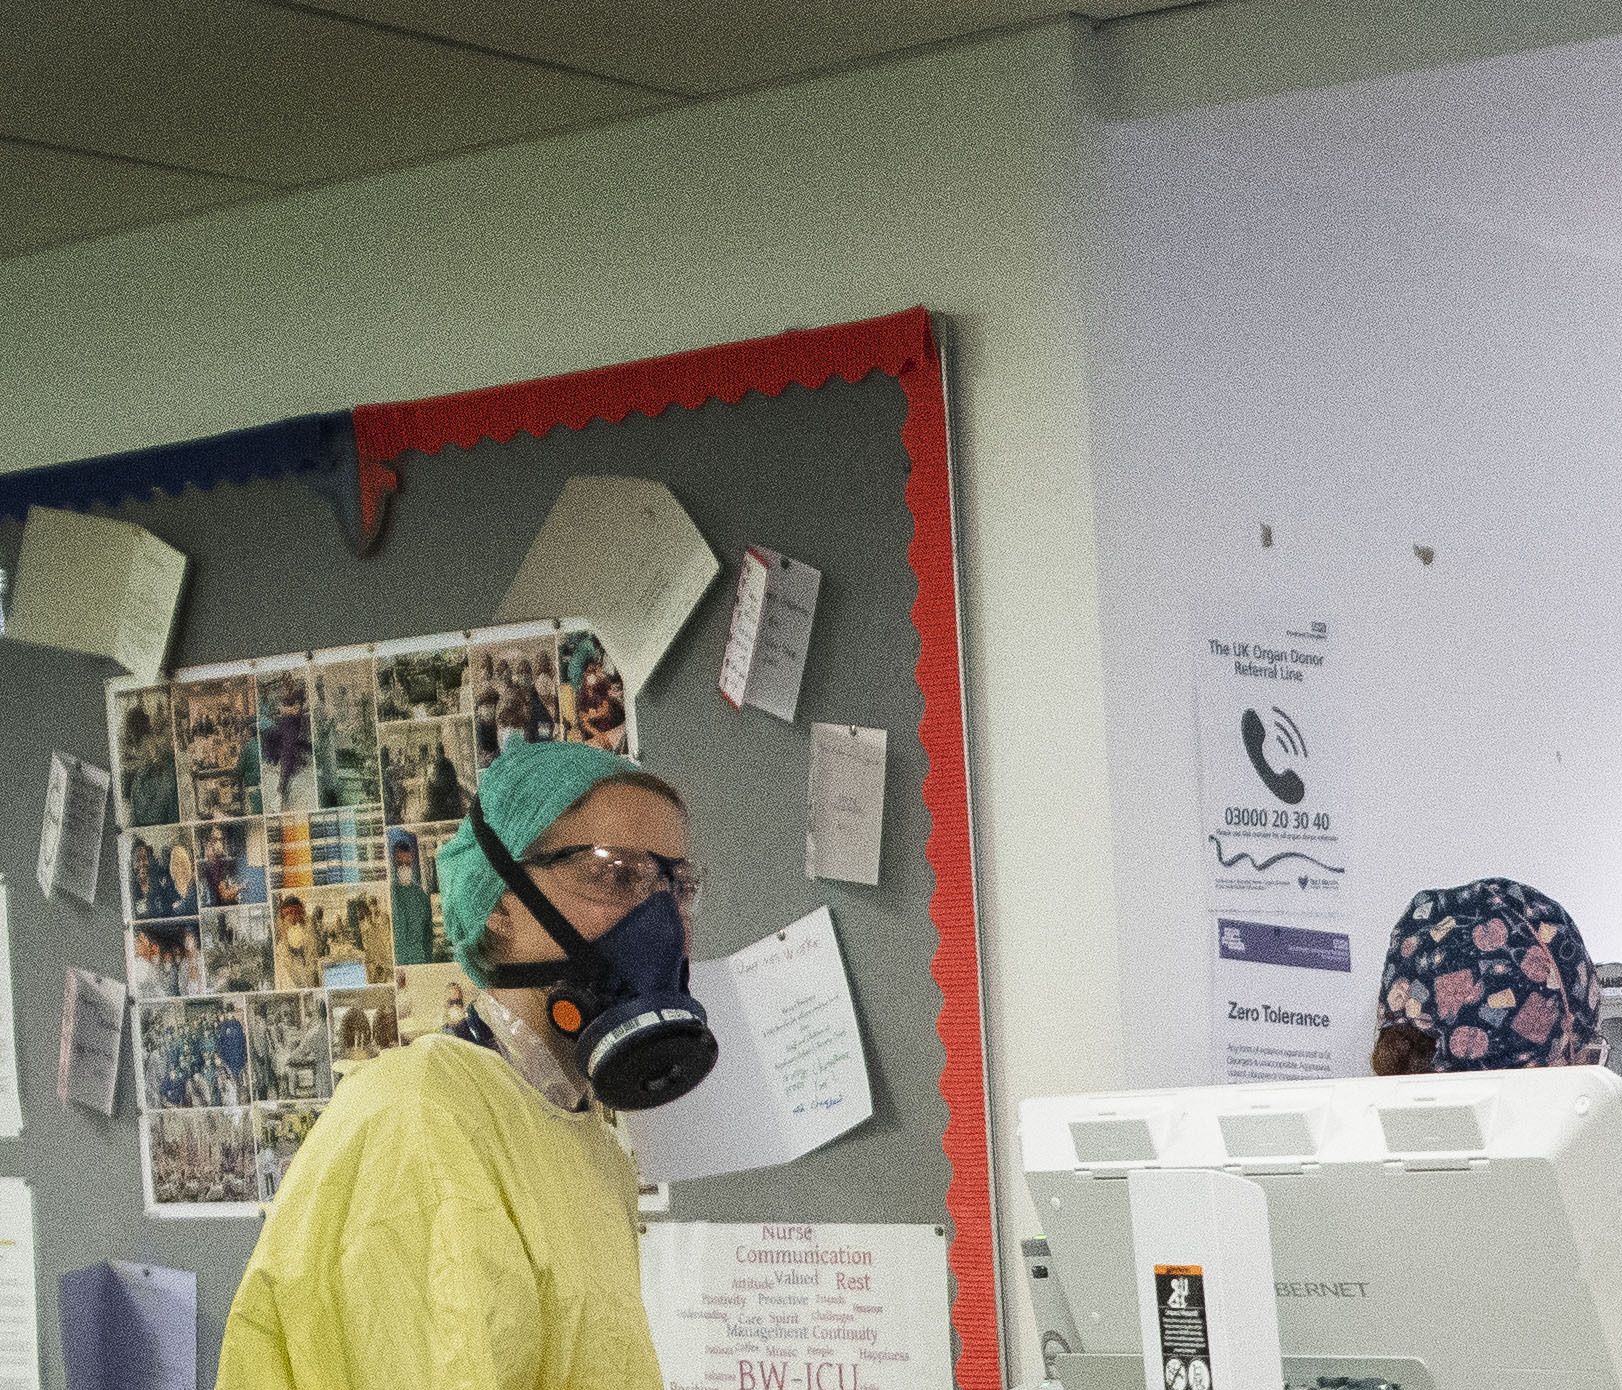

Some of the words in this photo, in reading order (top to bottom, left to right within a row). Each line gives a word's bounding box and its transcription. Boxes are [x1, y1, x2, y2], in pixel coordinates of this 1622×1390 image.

[1208, 639, 1230, 656] The
[1233, 642, 1249, 658] UK
[1253, 644, 1287, 664] Organ
[1290, 649, 1324, 666] Donor
[1234, 660, 1277, 679] Referral
[1280, 666, 1303, 682] Line
[1225, 807, 1268, 827] 03000
[1272, 810, 1289, 828] 20
[1293, 811, 1309, 830] 30
[1313, 812, 1330, 831] 40
[1228, 1001, 1260, 1022] Zero
[1262, 1004, 1330, 1028] Tolerance
[762, 1225, 813, 1241] Nurse
[735, 1245, 873, 1266] Communication
[774, 1269, 820, 1286] Valued
[835, 1272, 871, 1291] Rest
[738, 1313, 763, 1325] Care
[769, 1312, 800, 1326] Spirit
[726, 1324, 809, 1342] Management
[812, 1325, 879, 1346] Continuity
